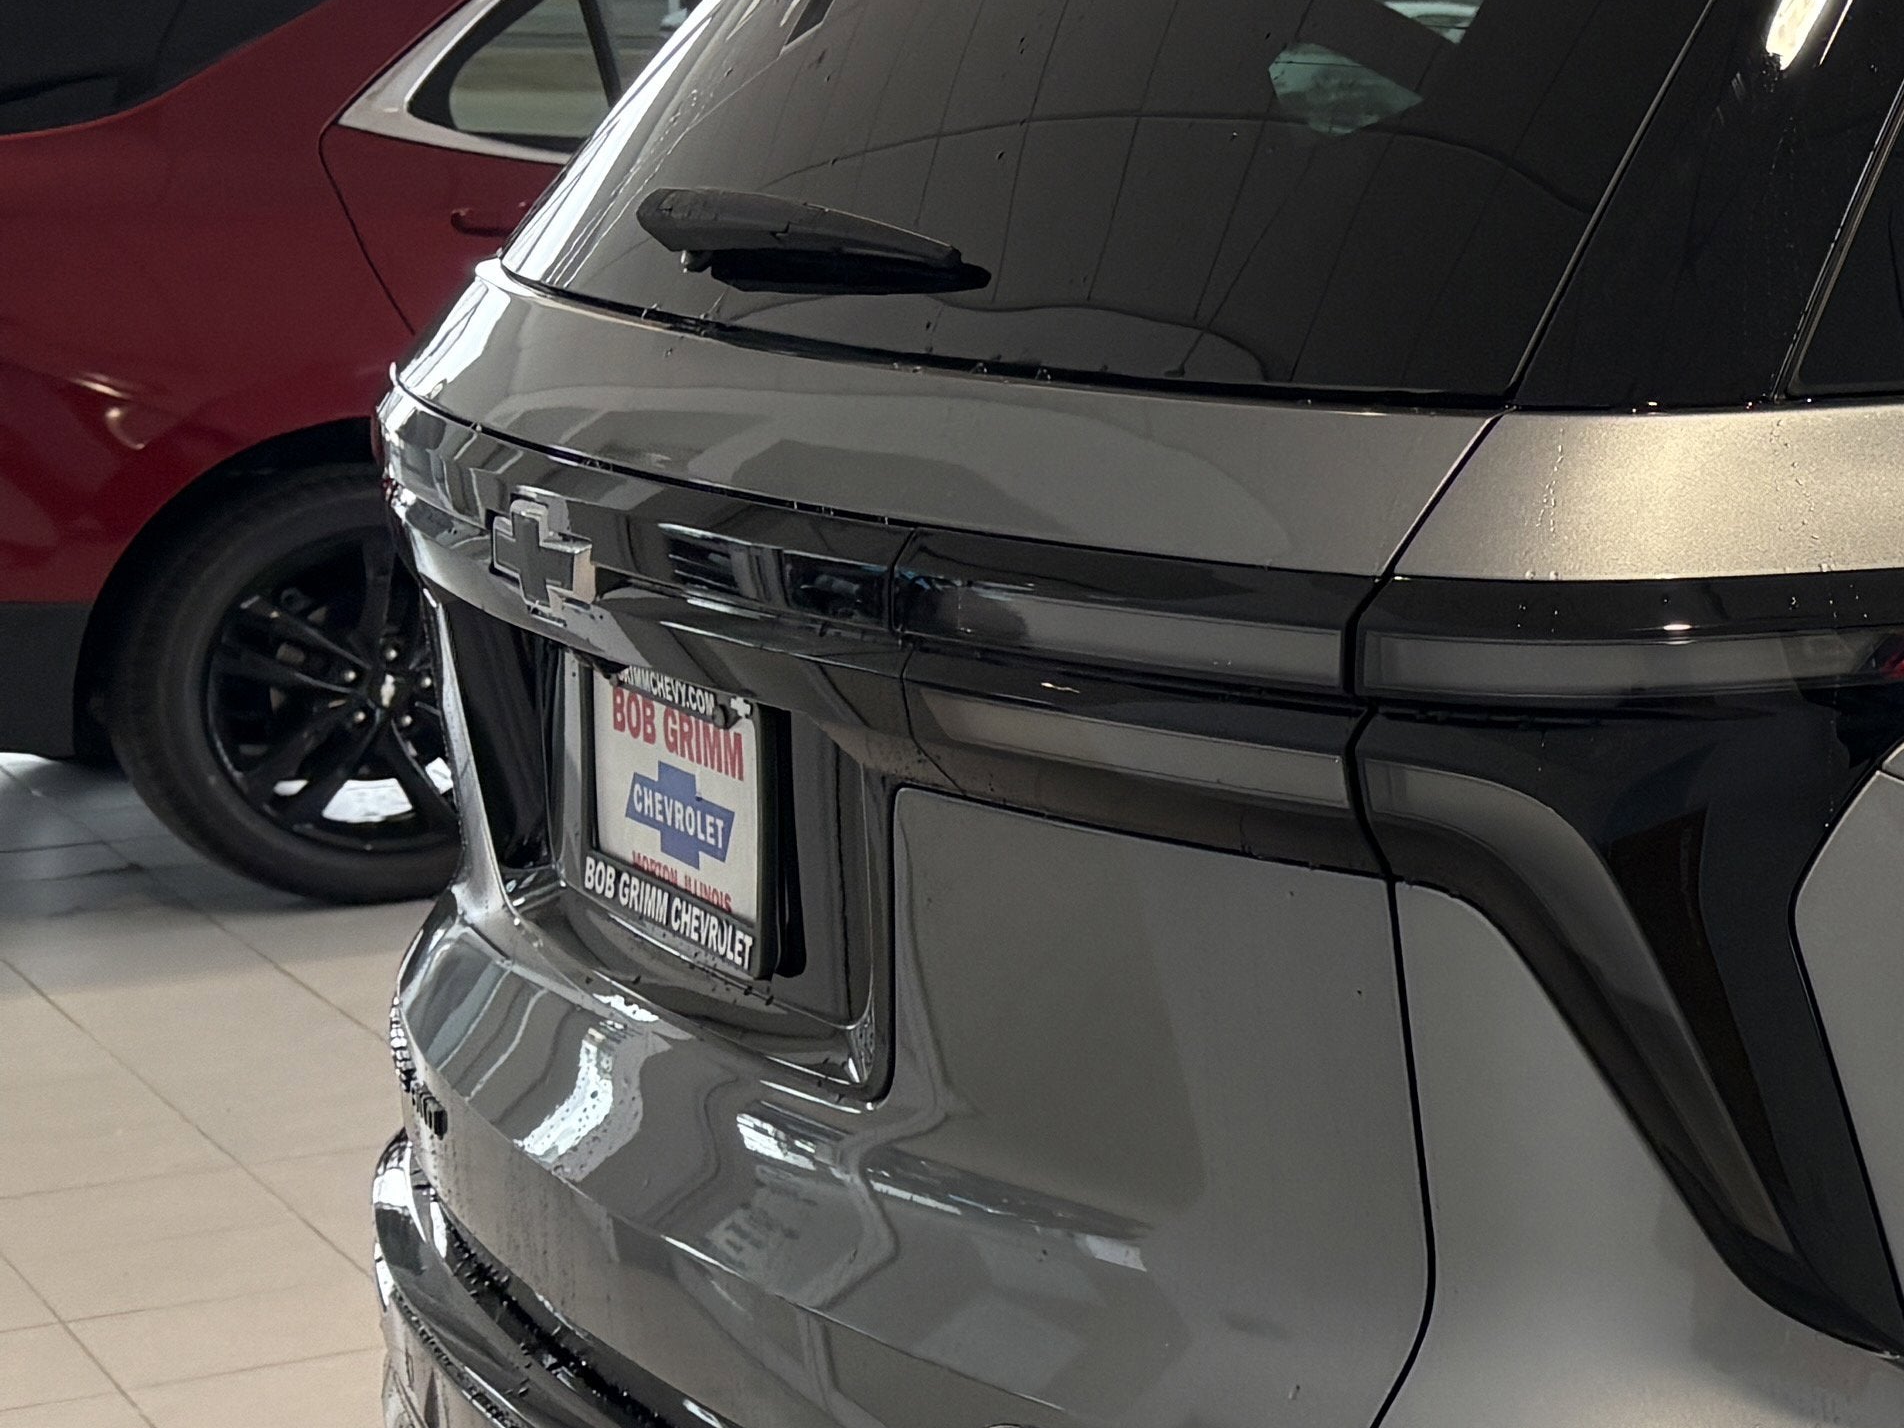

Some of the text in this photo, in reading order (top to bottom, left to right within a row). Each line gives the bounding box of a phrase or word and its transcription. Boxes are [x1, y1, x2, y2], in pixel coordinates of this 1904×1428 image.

[612, 685, 744, 781] BOB GRIMM
[633, 783, 724, 849] CHEVROLET
[584, 856, 753, 970] BOB GRIMM CHEVROLET
